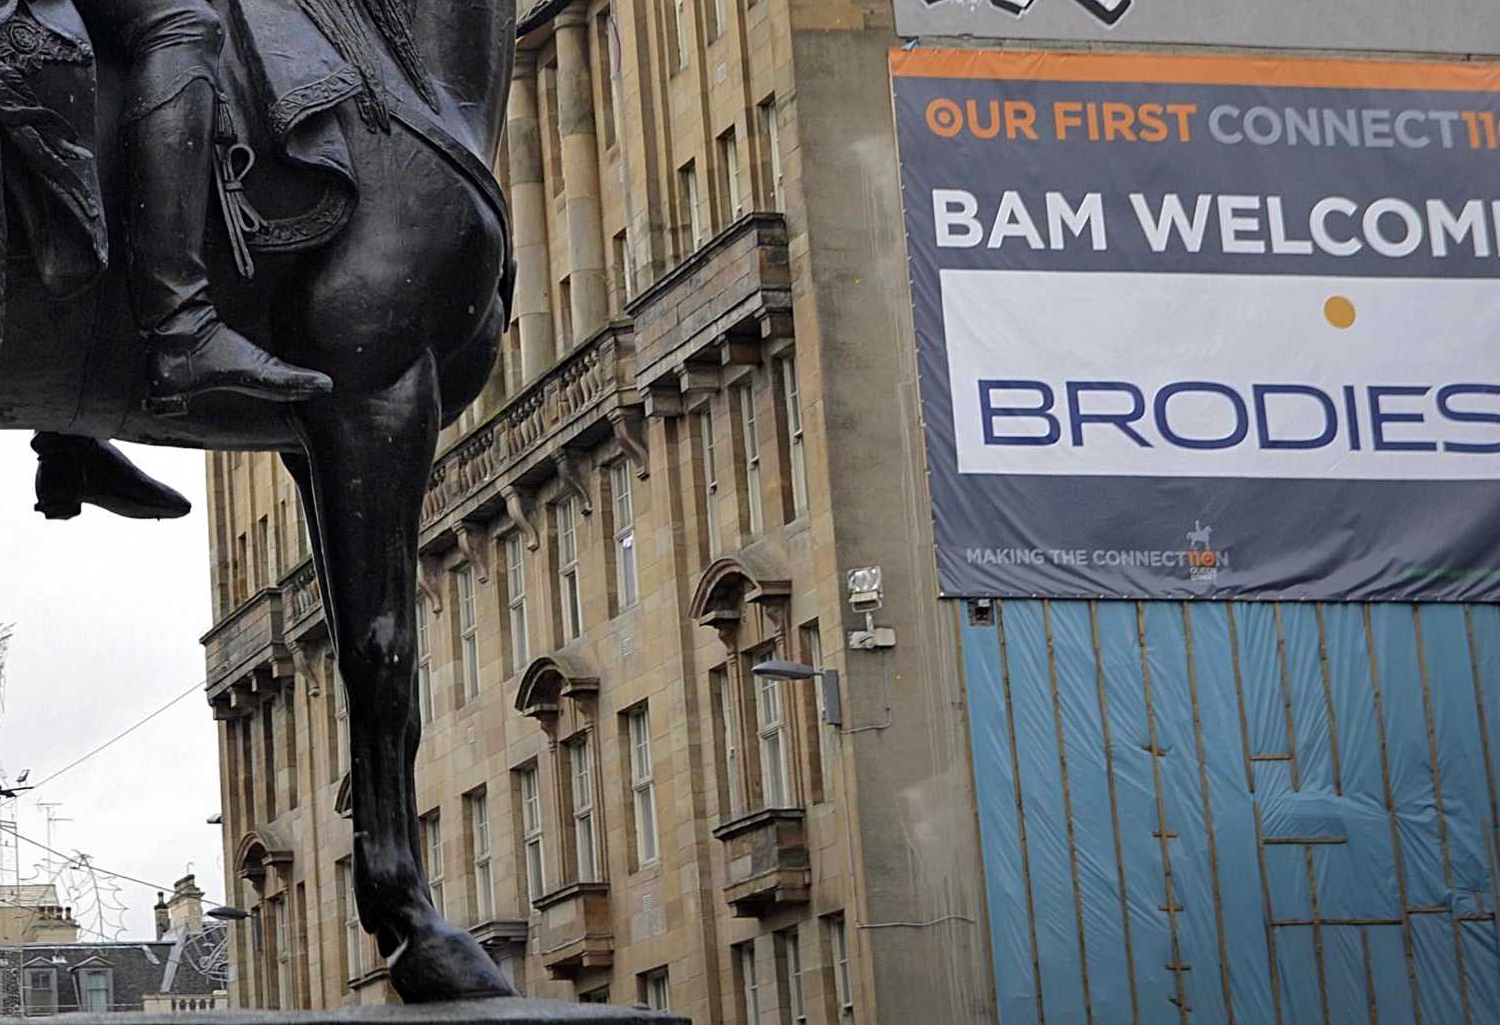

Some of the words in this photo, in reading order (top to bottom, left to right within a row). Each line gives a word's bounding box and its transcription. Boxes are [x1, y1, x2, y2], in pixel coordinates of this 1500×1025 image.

[925, 97, 1040, 140] OUR
[1053, 101, 1198, 143] FIRST
[1208, 105, 1500, 150] CONNECT11
[932, 189, 1107, 251] BAM
[977, 379, 1500, 454] BRODIES
[965, 548, 1045, 565] MAKING
[1048, 549, 1089, 565] THE
